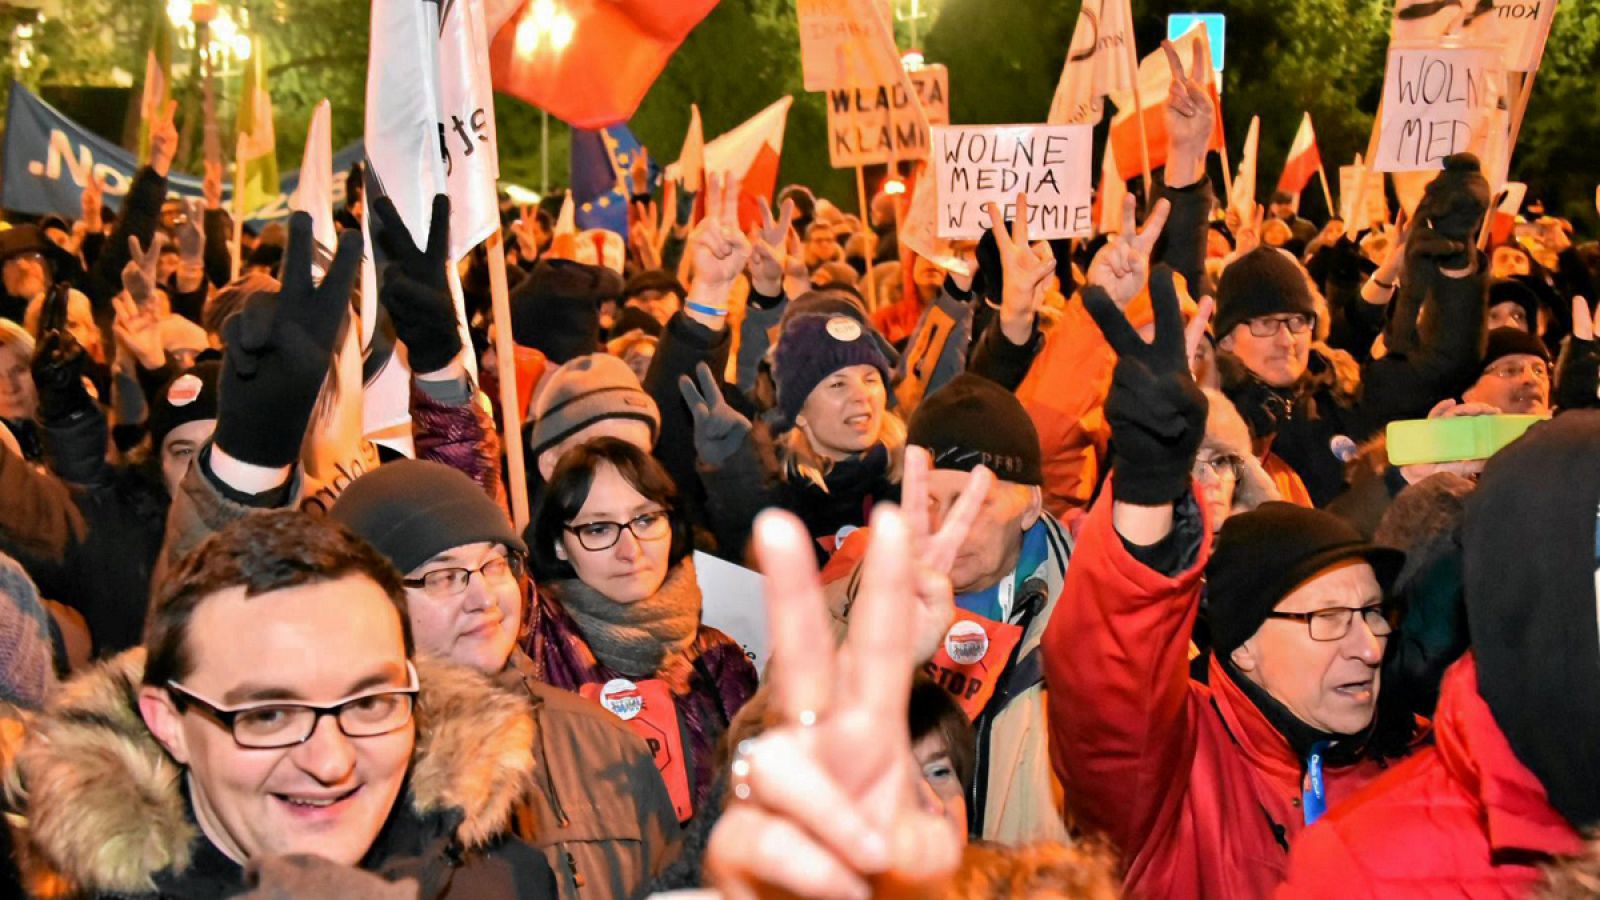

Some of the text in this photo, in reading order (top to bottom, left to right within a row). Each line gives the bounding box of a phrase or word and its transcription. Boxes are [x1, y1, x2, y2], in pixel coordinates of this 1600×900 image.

[944, 132, 1068, 168] WOLNE
[951, 167, 1061, 194] MEDIA
[947, 201, 1091, 231] W SEJMIE
